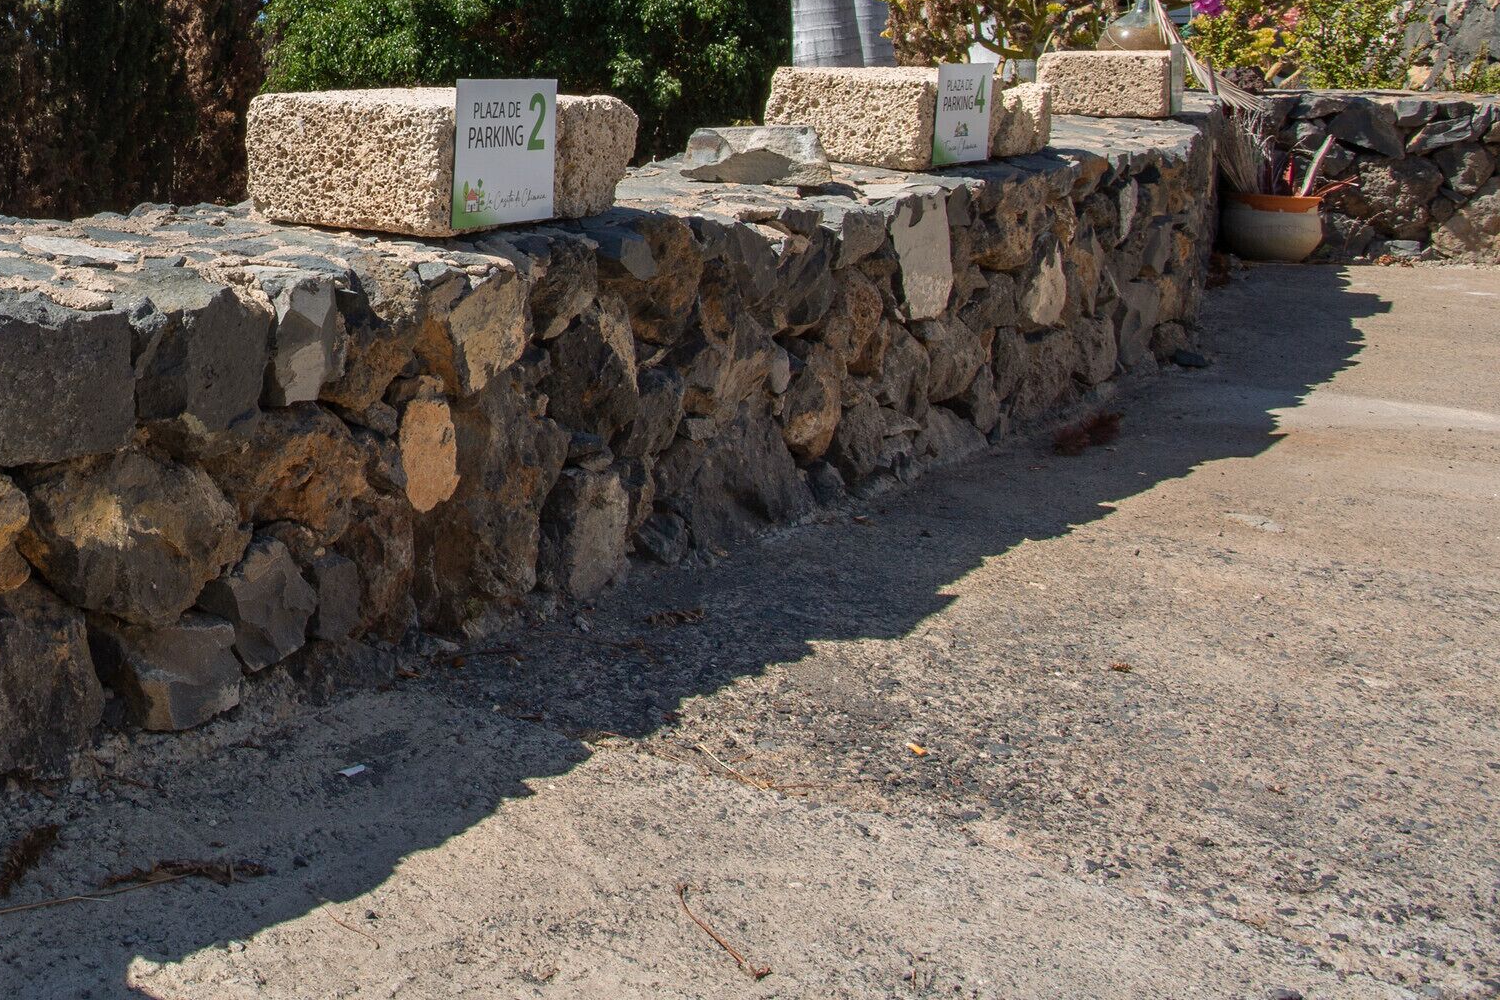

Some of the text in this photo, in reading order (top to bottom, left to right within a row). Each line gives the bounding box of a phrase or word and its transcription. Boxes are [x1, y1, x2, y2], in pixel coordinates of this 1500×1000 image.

[946, 79, 973, 92] PLAZA DE
[974, 75, 986, 113] 4
[473, 101, 521, 120] PLAZA DE
[943, 95, 974, 112] PARKING
[527, 92, 546, 150] 2
[468, 125, 524, 149] PARKING
